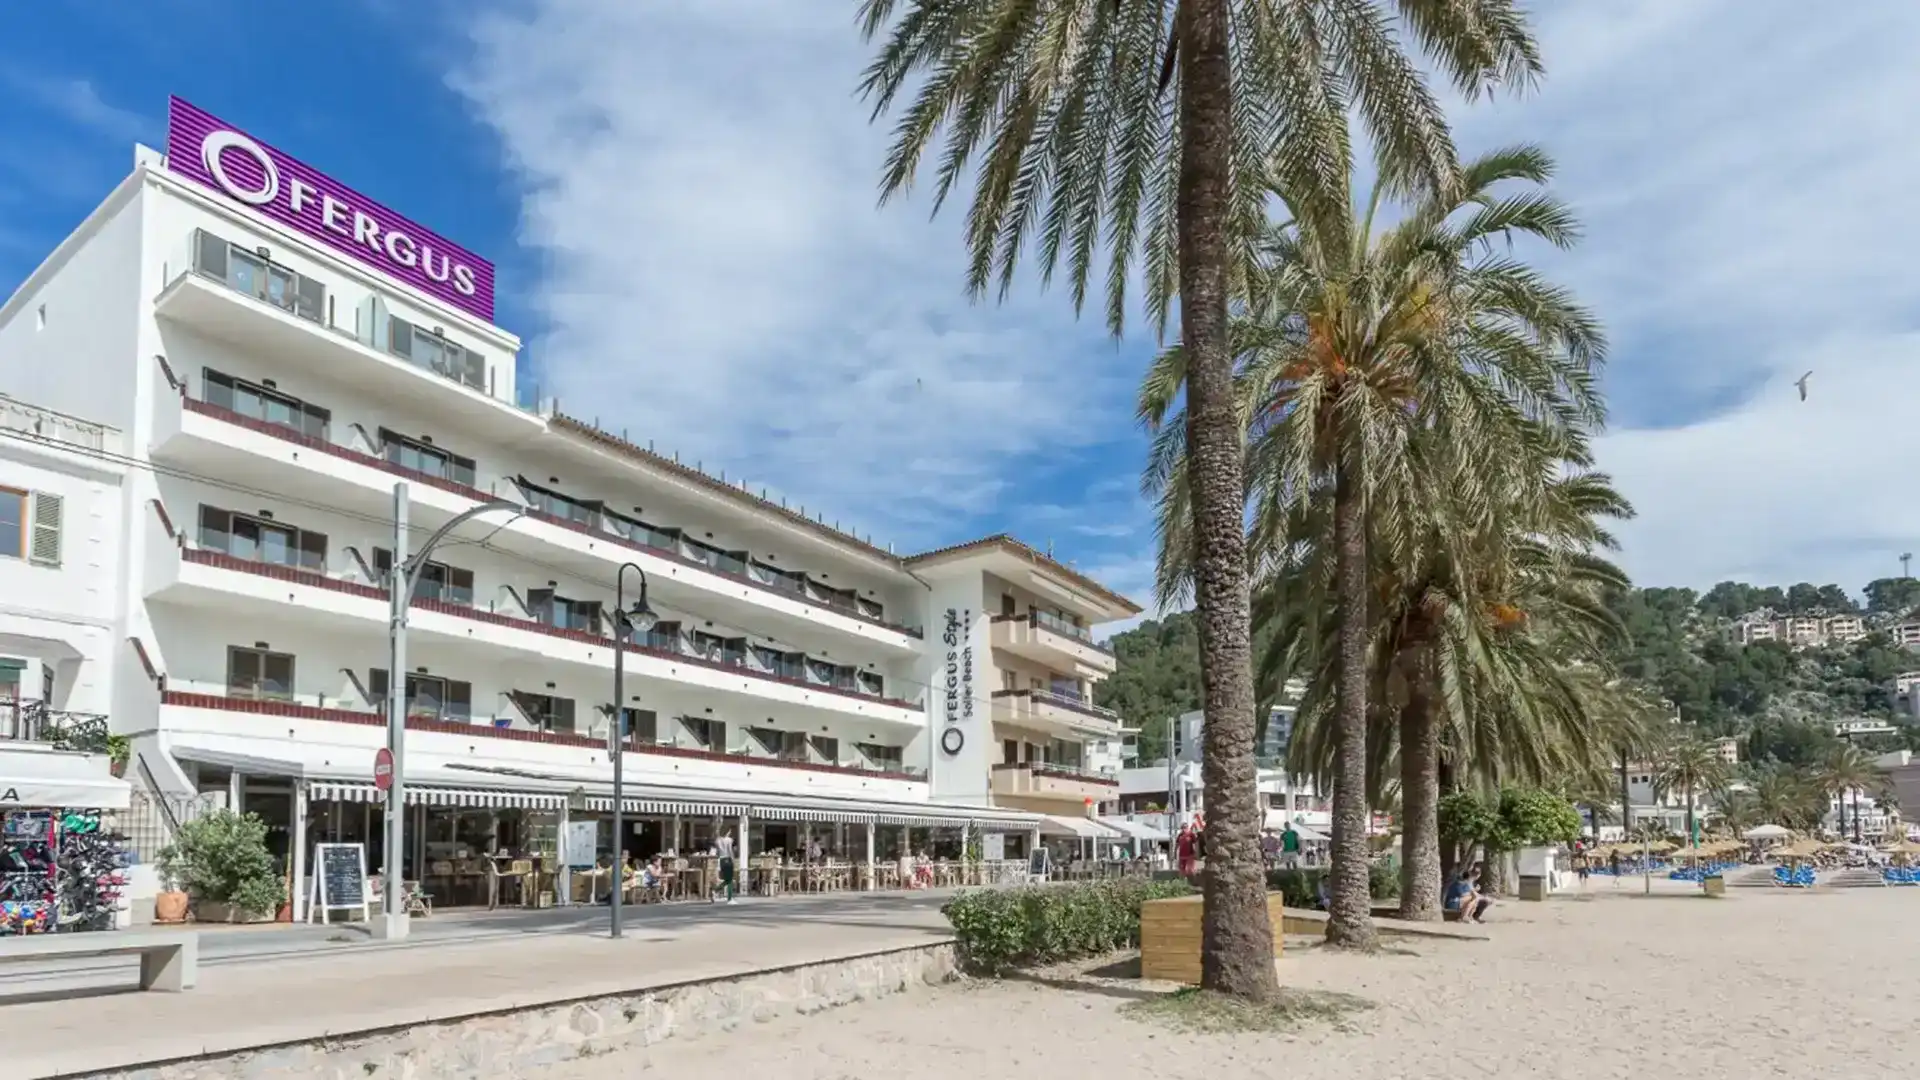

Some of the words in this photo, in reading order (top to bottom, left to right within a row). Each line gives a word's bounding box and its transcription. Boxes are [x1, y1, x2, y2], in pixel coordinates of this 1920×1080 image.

[289, 177, 476, 296] FERGUS
[943, 608, 962, 647] Style
[946, 651, 959, 722] FERGUS
[962, 646, 973, 682] Beach
